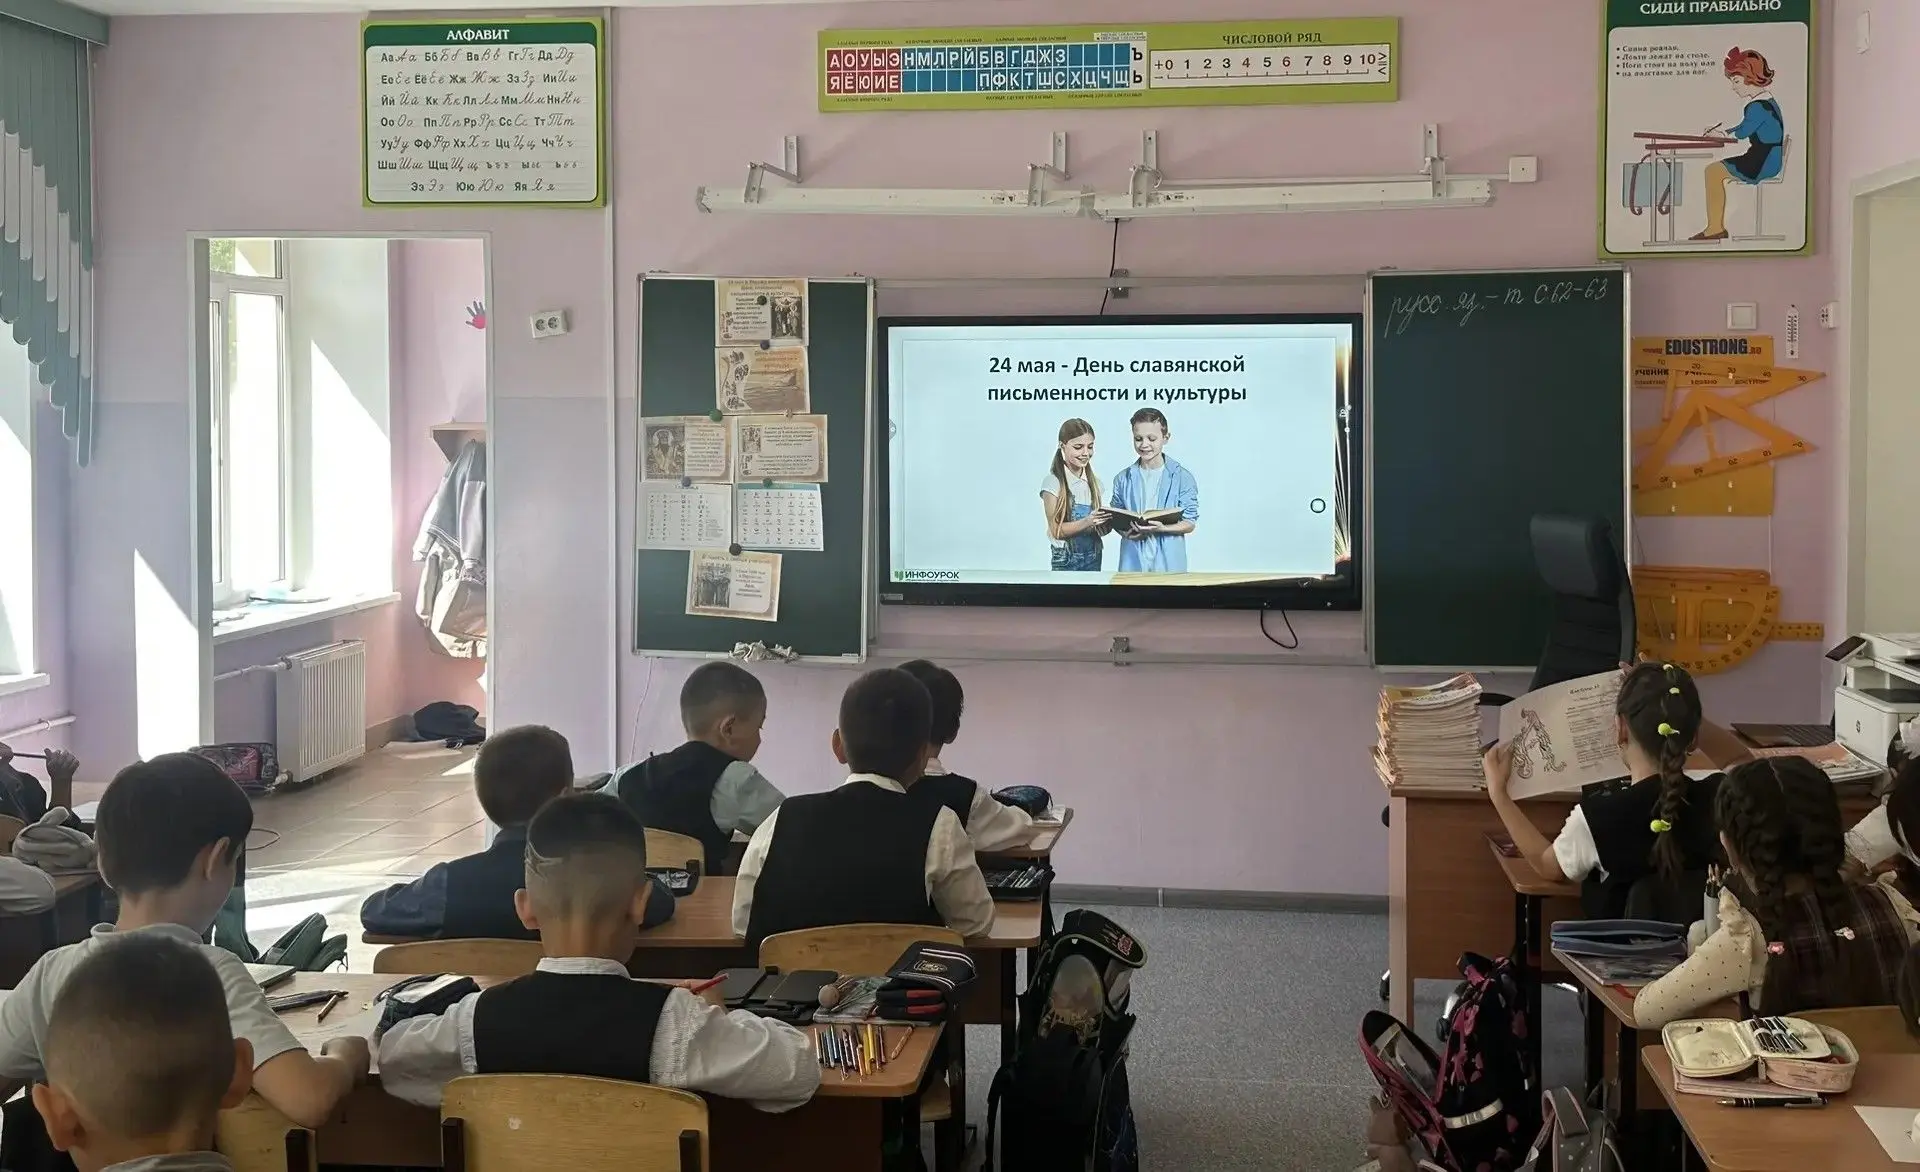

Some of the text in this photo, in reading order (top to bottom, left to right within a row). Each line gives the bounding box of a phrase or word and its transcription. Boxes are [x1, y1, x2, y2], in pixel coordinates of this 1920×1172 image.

[1640, 0, 1782, 15] СИДИ ПРАВИЛЬНО
[446, 28, 510, 41] АЛФАВИТ
[1222, 32, 1322, 45] ЧИСЛОВОЙ РЯД
[1185, 59, 1190, 70] 1
[1204, 59, 1212, 69] 2
[1223, 58, 1231, 69] 3
[1242, 58, 1250, 68] 4
[1264, 57, 1272, 67] 5
[1283, 56, 1291, 67] 6
[1304, 56, 1313, 66] 7
[1323, 55, 1331, 66] 8
[1343, 55, 1352, 65] 9
[1360, 54, 1376, 64] 10
[988, 356, 1011, 374] 24
[1017, 359, 1055, 374] мая
[1073, 356, 1124, 376] День
[1130, 354, 1246, 374] славянской
[988, 386, 1247, 406] письменности и культуры
[905, 571, 960, 579] ИНФОУРОК
